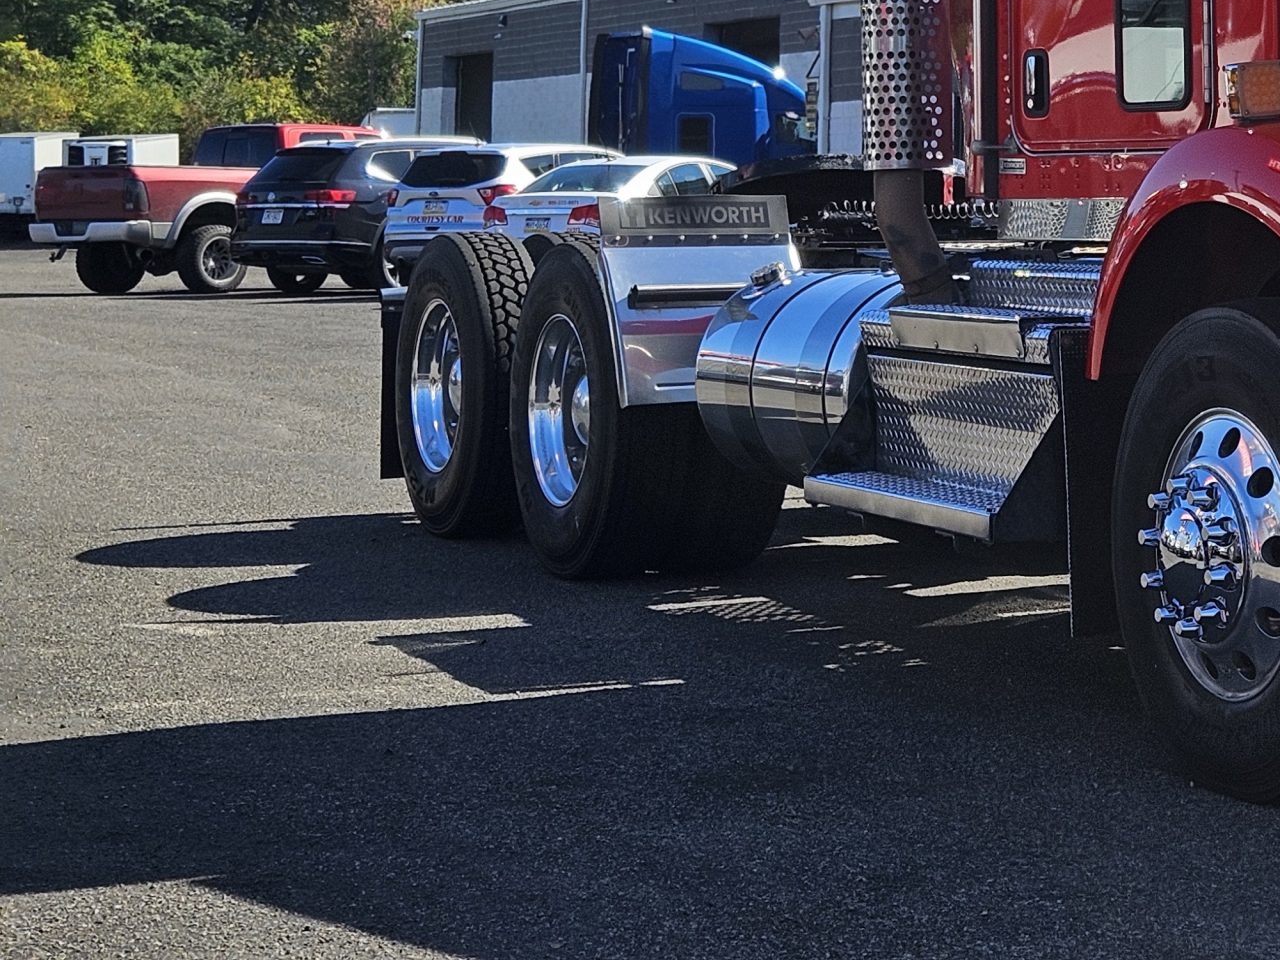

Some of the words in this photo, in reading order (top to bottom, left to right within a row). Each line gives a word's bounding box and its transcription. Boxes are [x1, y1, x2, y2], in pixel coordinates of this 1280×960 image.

[407, 215, 445, 223] COURTESY
[446, 215, 464, 223] CAR
[650, 205, 765, 225] KENWORTH
